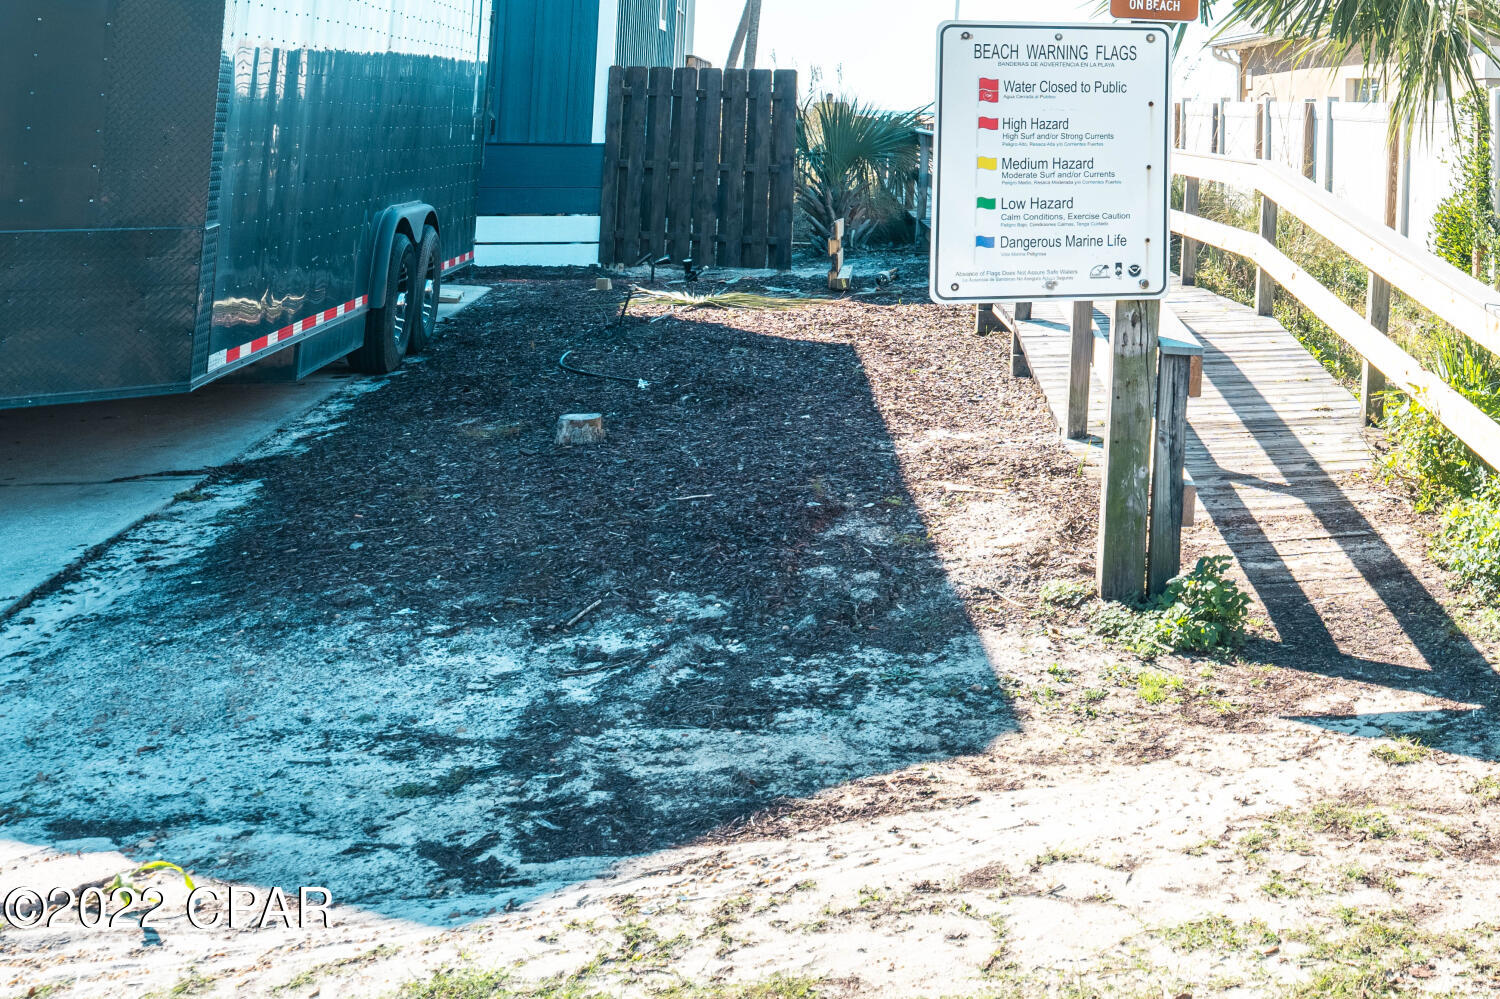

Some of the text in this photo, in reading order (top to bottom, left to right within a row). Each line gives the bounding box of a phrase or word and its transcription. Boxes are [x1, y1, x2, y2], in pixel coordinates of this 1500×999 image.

[1146, 0, 1180, 12] BEACH
[974, 44, 1137, 61] BEACH WARNING FLAGS
[1004, 80, 1127, 93] Water Closed to Public
[1002, 117, 1069, 132] High Hazard
[1002, 132, 1018, 141] High
[1061, 132, 1083, 141] Strong
[1002, 157, 1094, 170] Medium Hazard
[1001, 197, 1074, 209] Low Hazard
[1023, 213, 1065, 221] Conditions,
[1000, 234, 1127, 250] Dangerous Marine Life
